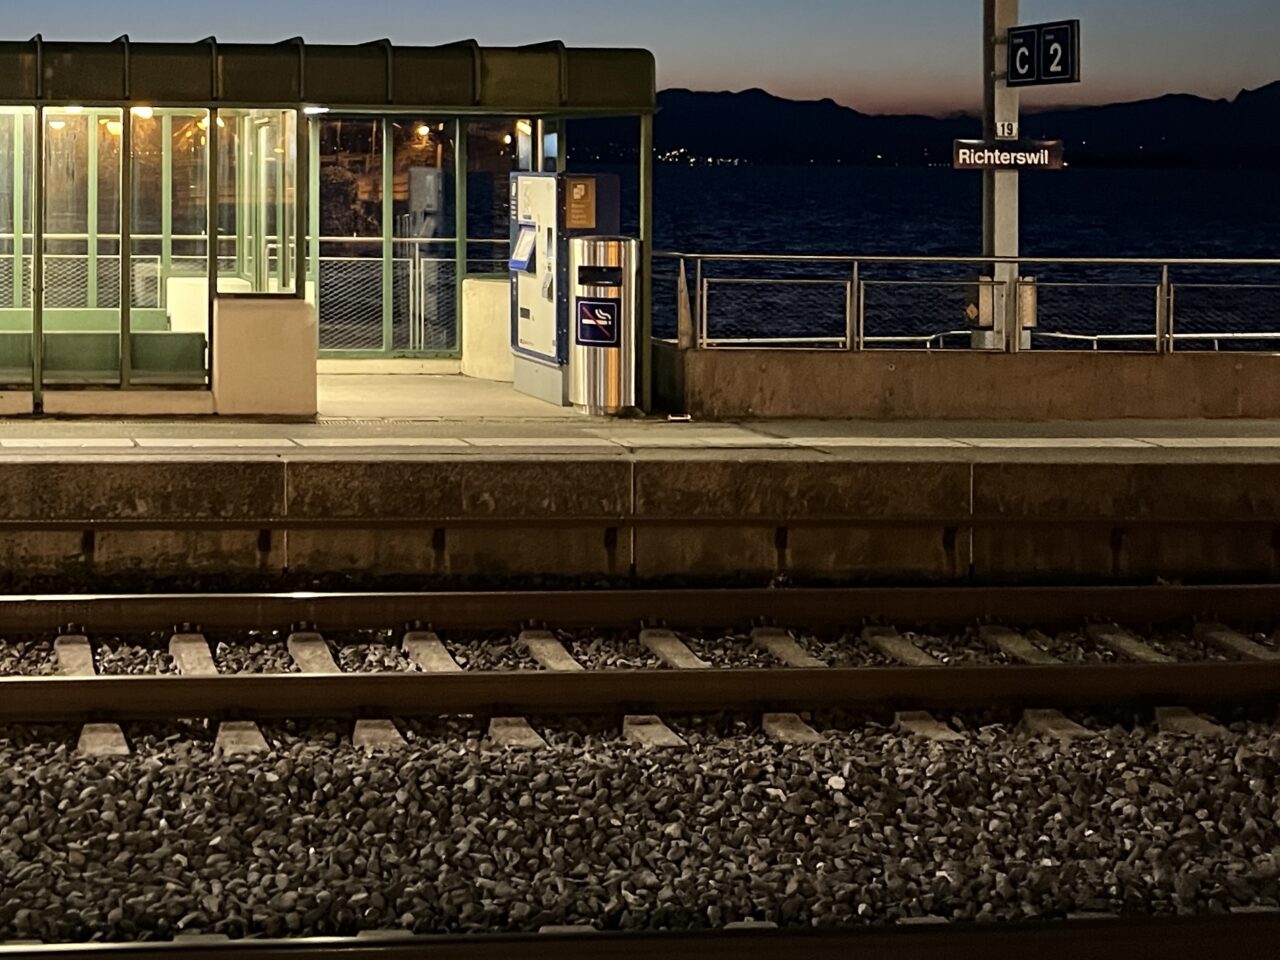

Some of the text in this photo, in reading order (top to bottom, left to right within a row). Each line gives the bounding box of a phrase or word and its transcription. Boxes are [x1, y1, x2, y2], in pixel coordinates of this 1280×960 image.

[1016, 46, 1029, 74] C
[1049, 42, 1062, 72] 2
[1000, 122, 1014, 136] 19
[958, 148, 1049, 165] Richterswil
